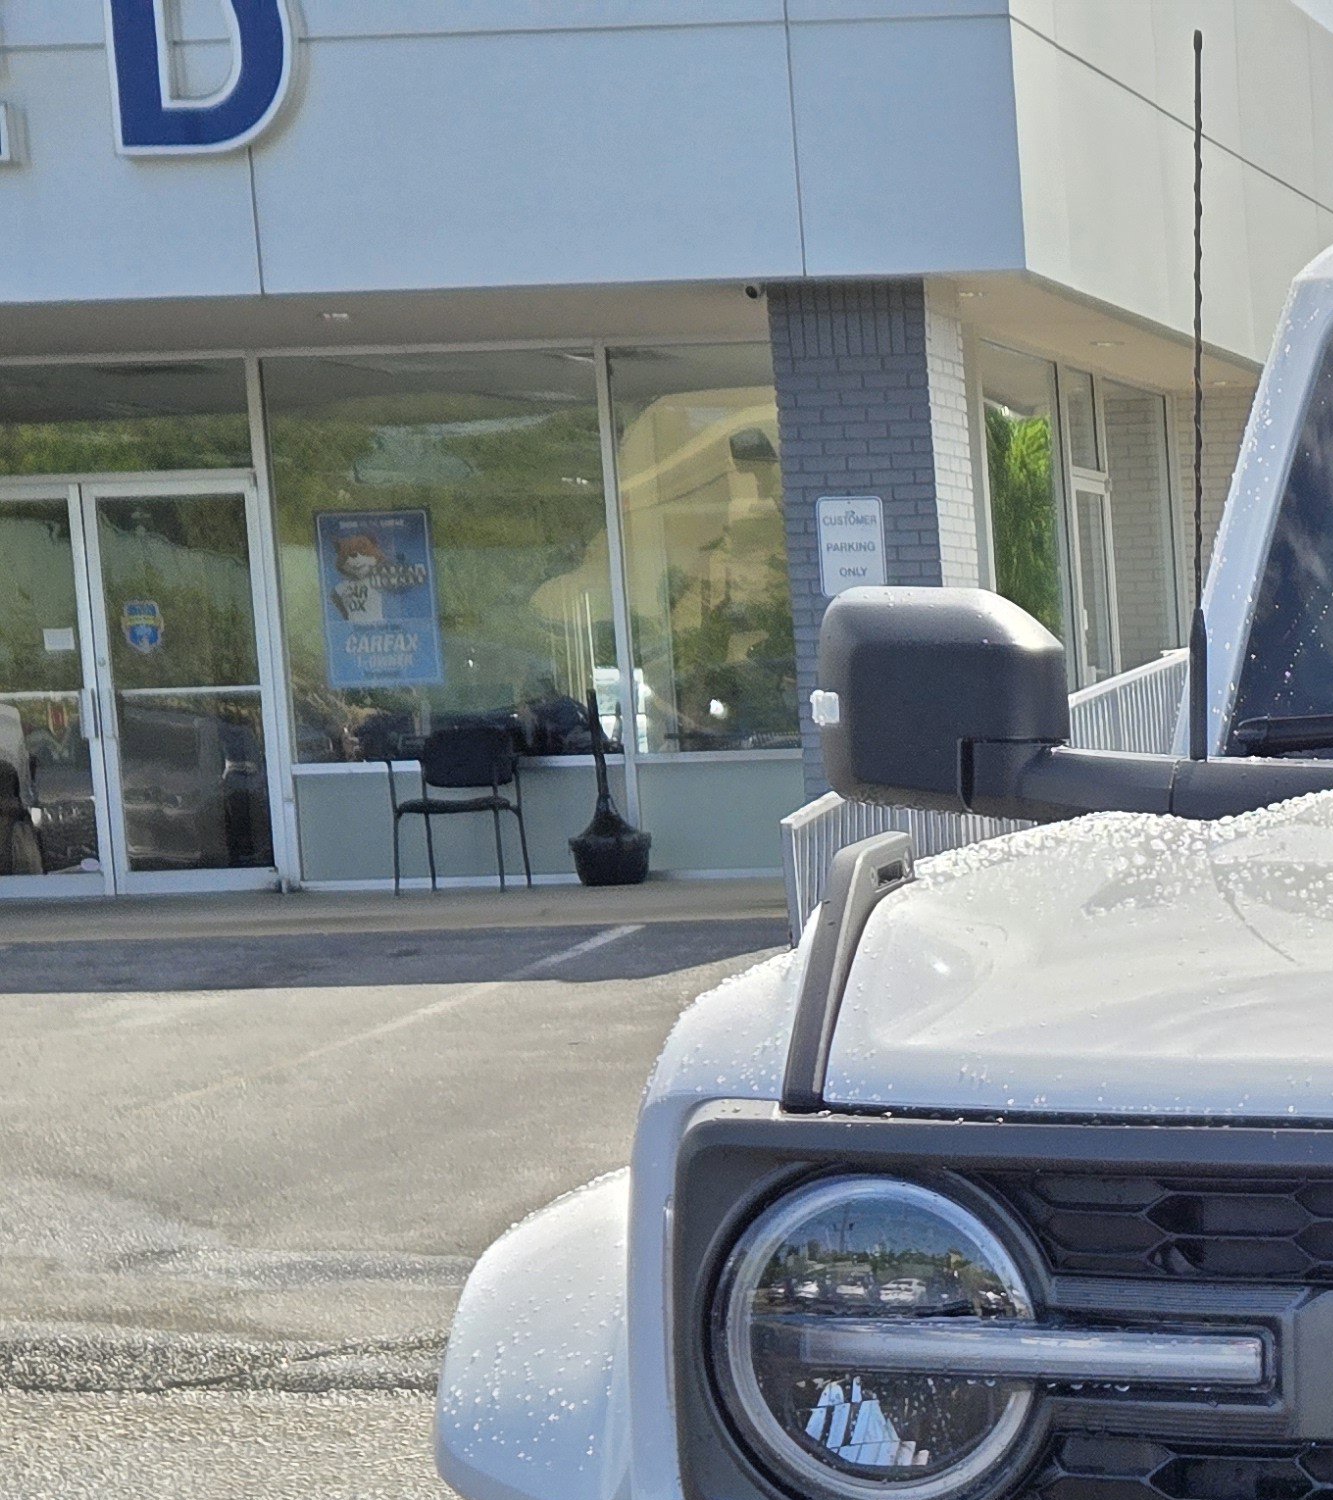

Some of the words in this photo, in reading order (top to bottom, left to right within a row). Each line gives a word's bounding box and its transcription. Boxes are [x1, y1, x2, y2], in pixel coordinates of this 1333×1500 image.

[822, 514, 878, 526] CUSTOMER
[826, 541, 876, 552] PARKING
[839, 566, 867, 577] ONLY
[345, 633, 419, 653] CARFAX
